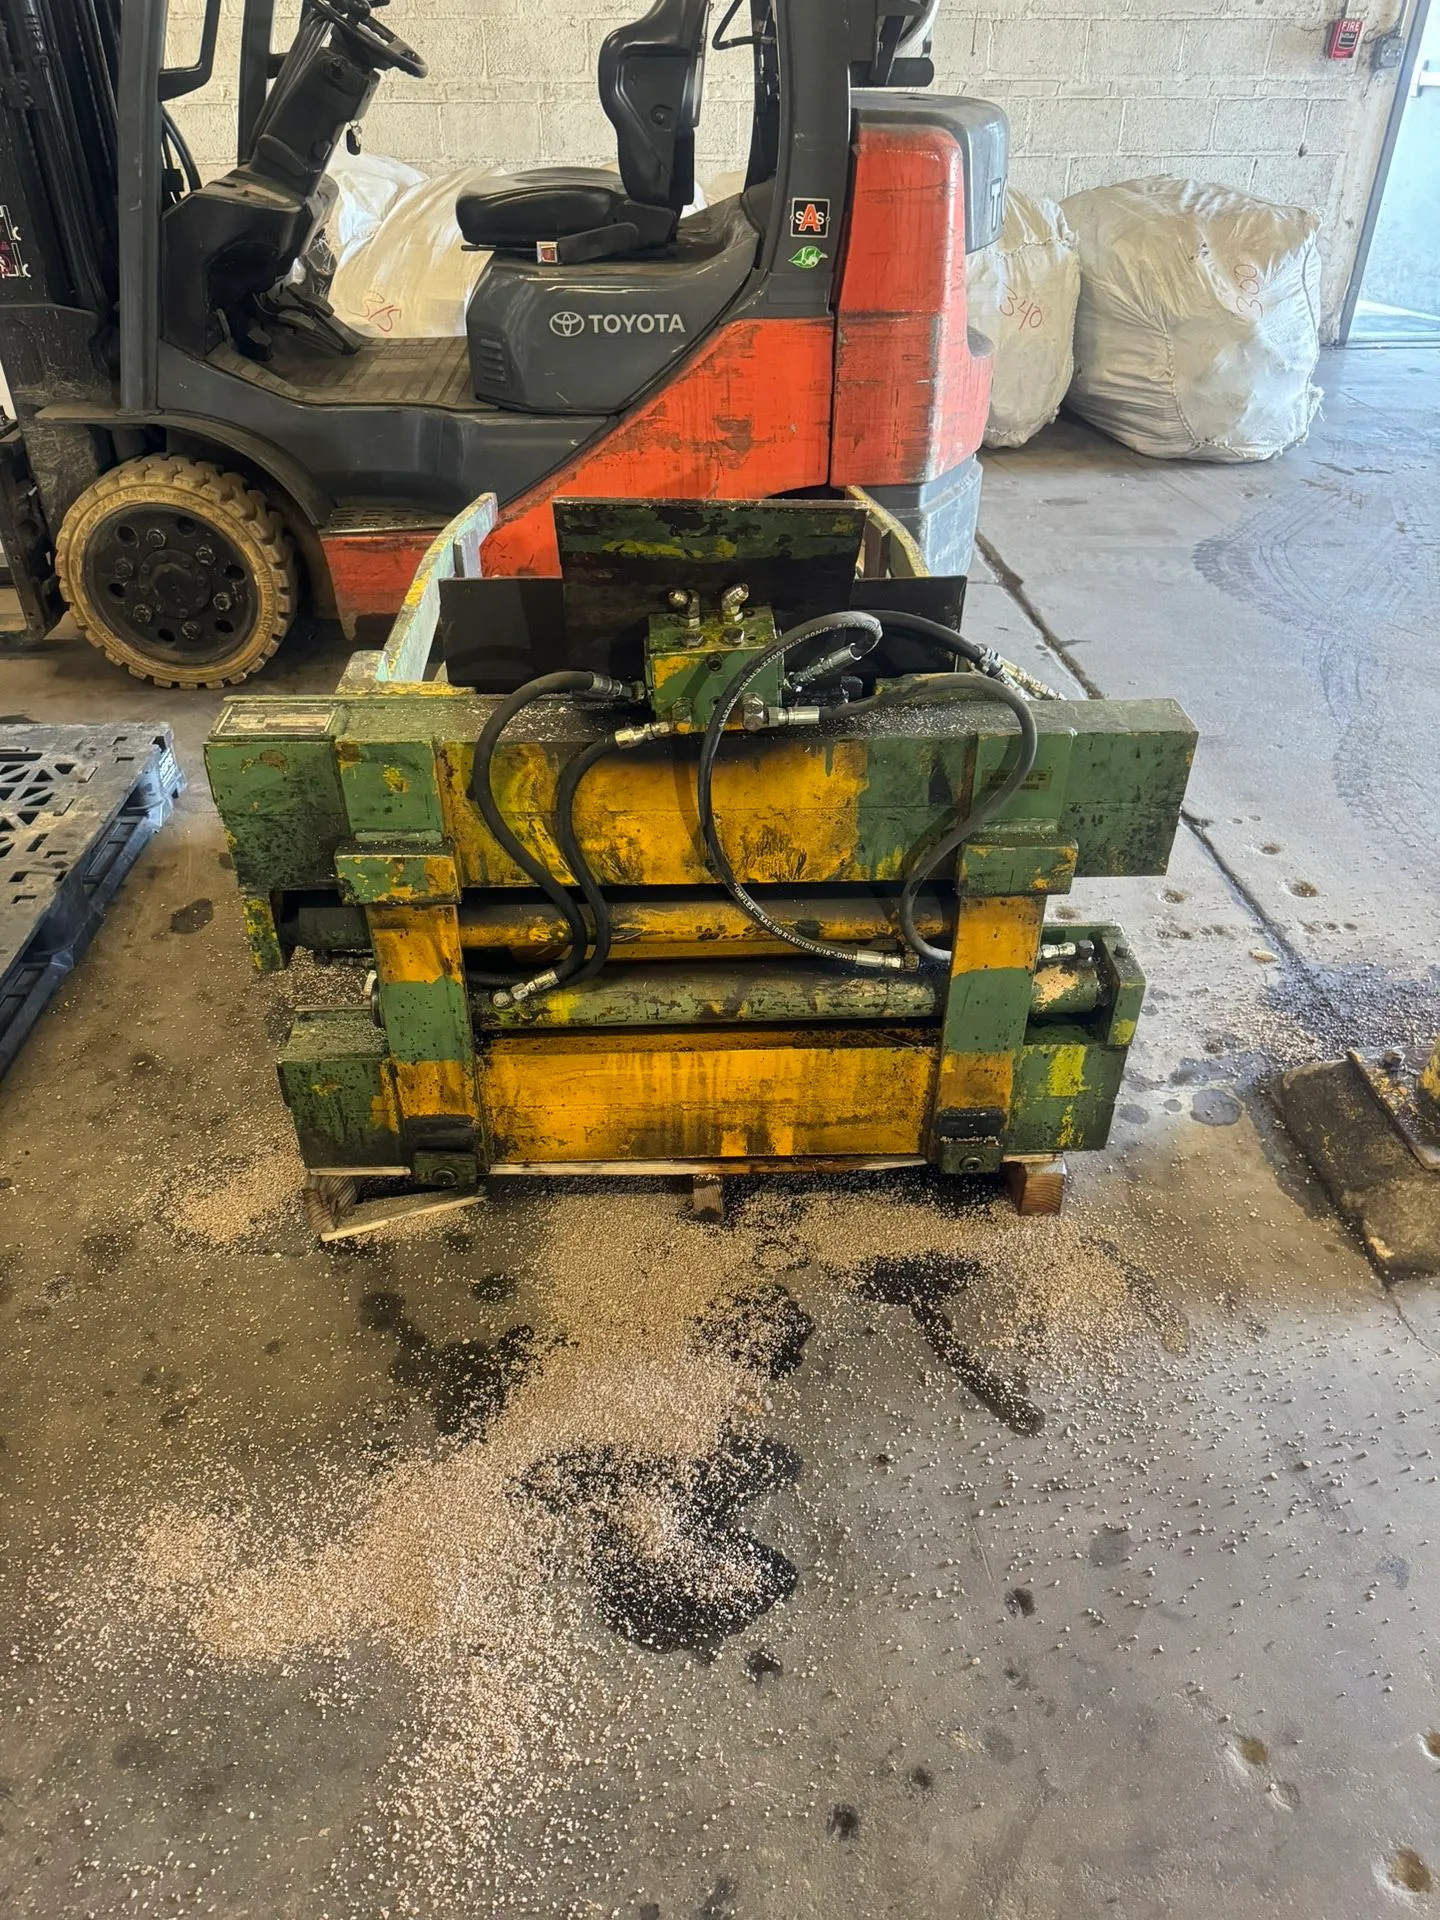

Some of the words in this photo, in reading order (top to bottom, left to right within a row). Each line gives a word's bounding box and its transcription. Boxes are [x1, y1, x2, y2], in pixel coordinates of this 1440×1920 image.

[1341, 21, 1361, 31] FIRE
[795, 204, 825, 232] SAS
[1000, 282, 1042, 330] 340
[588, 314, 686, 333] TOYOTA
[759, 914, 772, 928] SAE
[772, 925, 783, 935] 100
